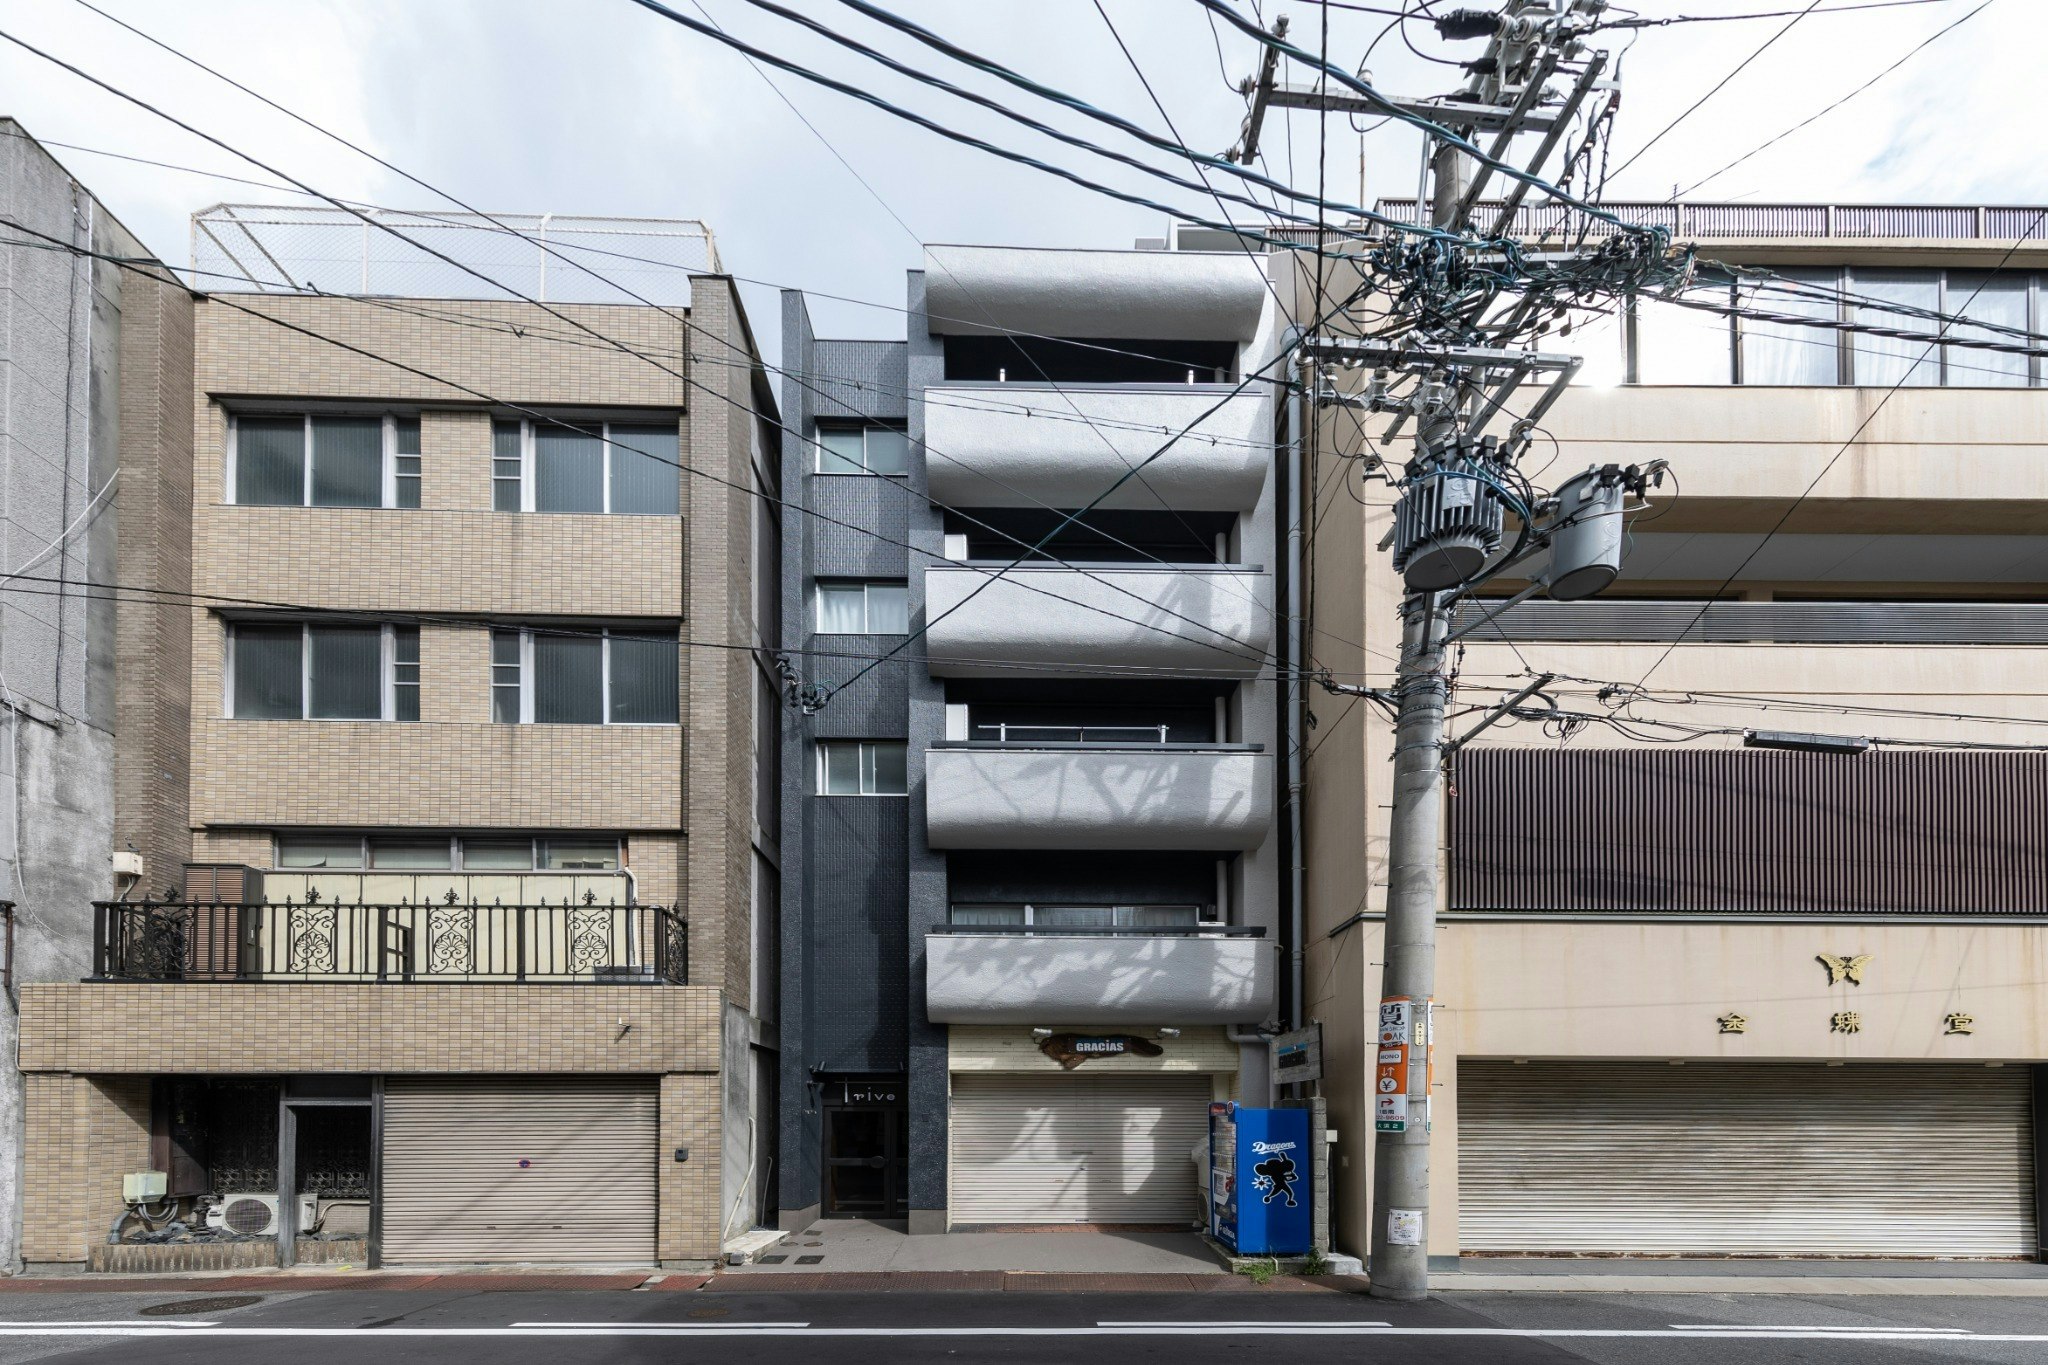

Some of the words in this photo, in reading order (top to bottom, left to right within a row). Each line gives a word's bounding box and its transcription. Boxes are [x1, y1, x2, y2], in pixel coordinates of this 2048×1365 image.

[1380, 1002, 1405, 1027] 質
[1717, 1011, 1975, 1035] 金蝶堂
[1076, 1039, 1124, 1052] GRACIAS
[1252, 1141, 1297, 1155] Dragons
